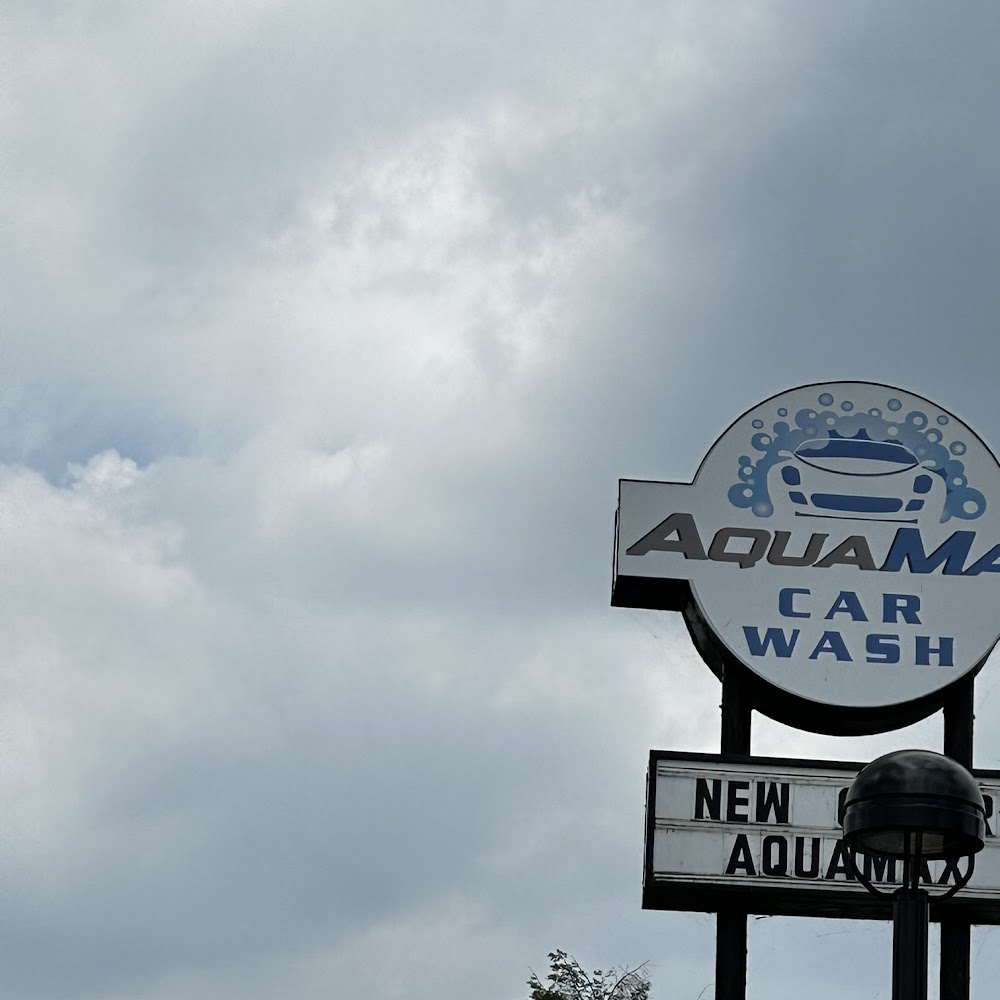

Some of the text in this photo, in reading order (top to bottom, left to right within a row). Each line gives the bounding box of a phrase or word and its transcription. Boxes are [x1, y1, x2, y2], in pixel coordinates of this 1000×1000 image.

[778, 587, 922, 624] CAR
[742, 626, 954, 667] WASH
[695, 778, 790, 824] NEW
